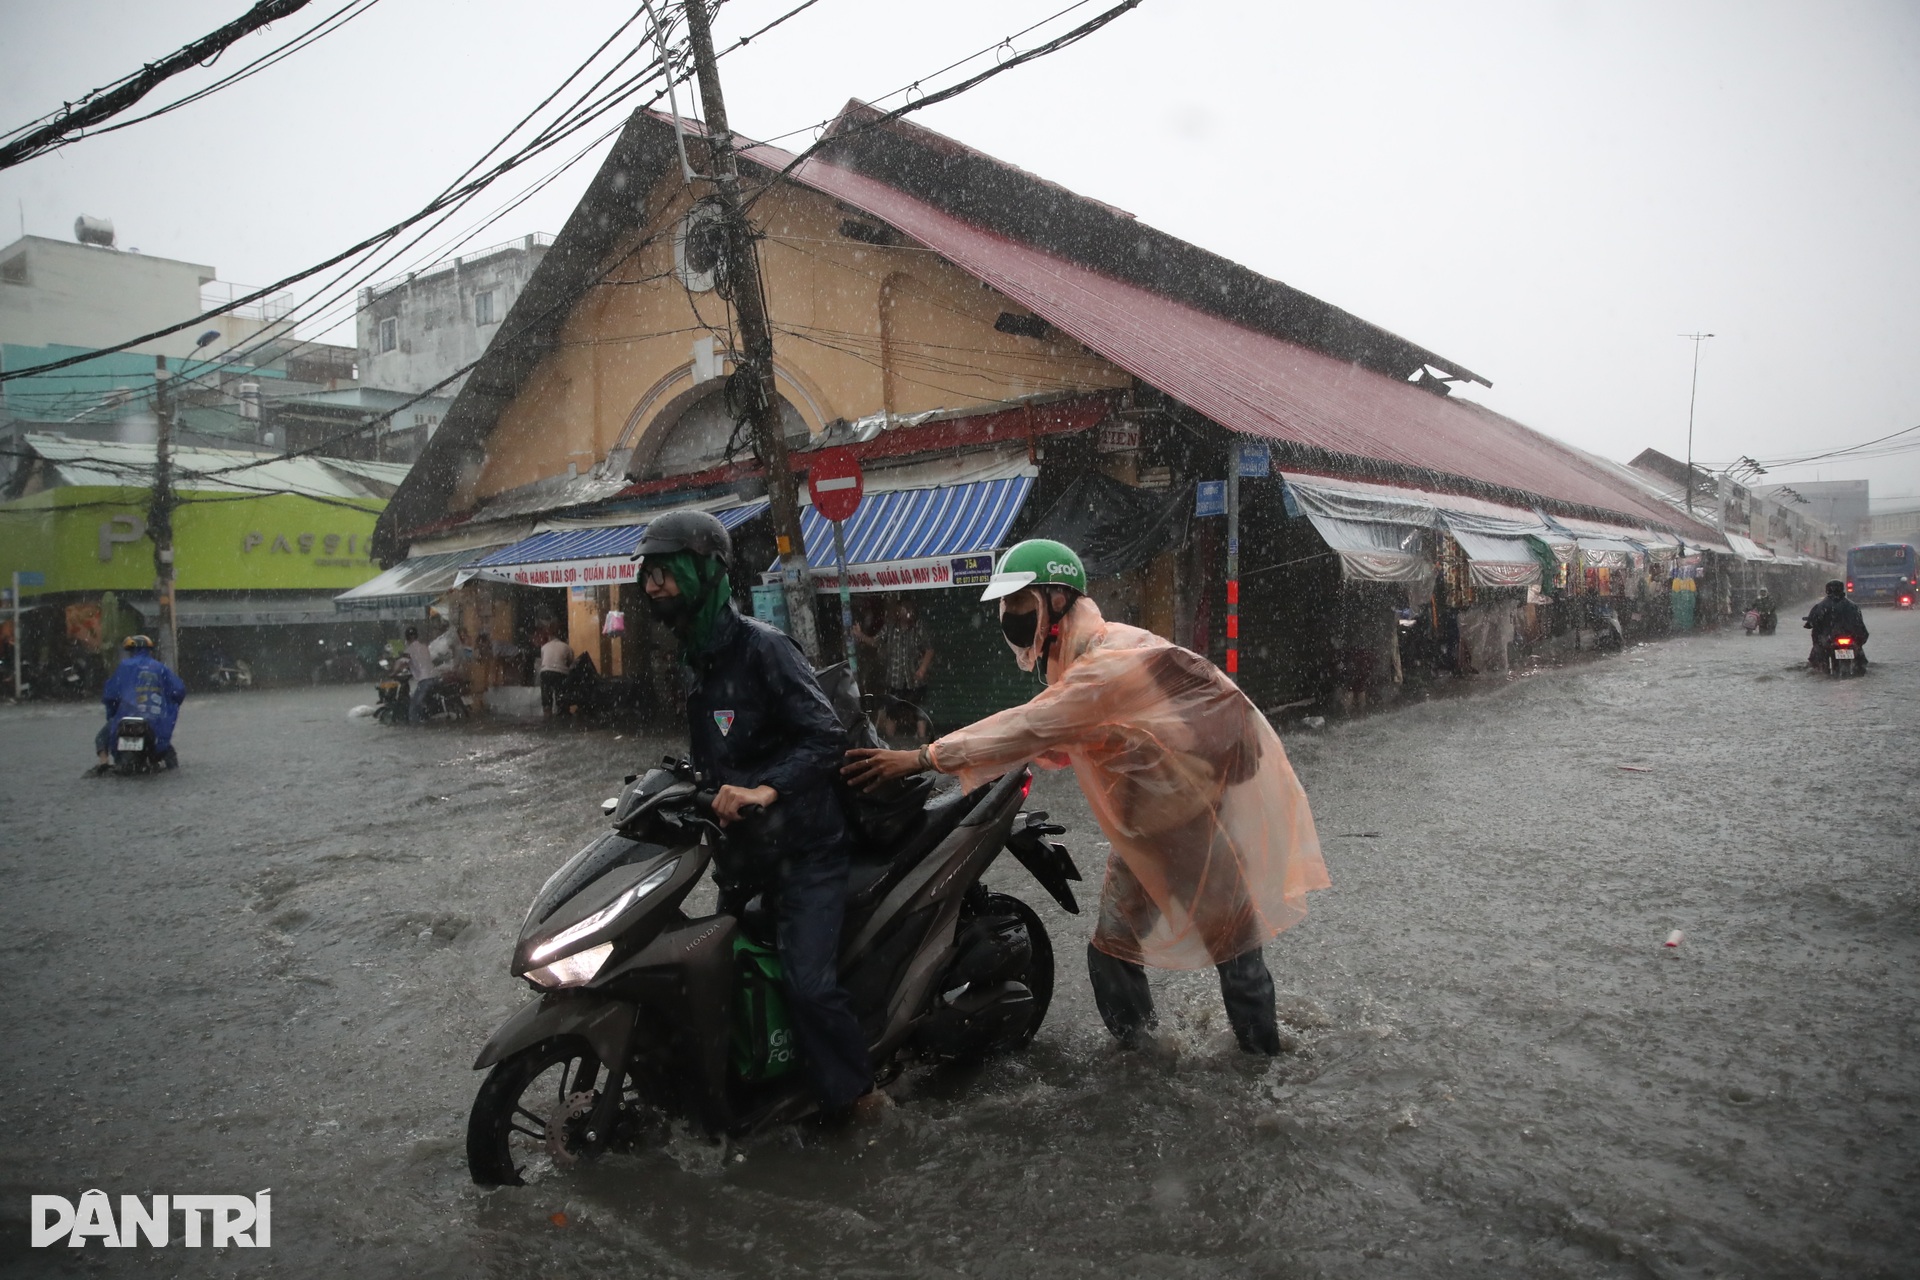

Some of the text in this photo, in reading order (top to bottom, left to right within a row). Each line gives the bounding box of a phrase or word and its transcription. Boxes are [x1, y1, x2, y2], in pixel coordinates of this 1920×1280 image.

[100, 515, 147, 562] P
[619, 564, 636, 578] MAY
[912, 568, 930, 583] MAY
[1046, 561, 1078, 577] Grab
[686, 924, 720, 951] HONDA
